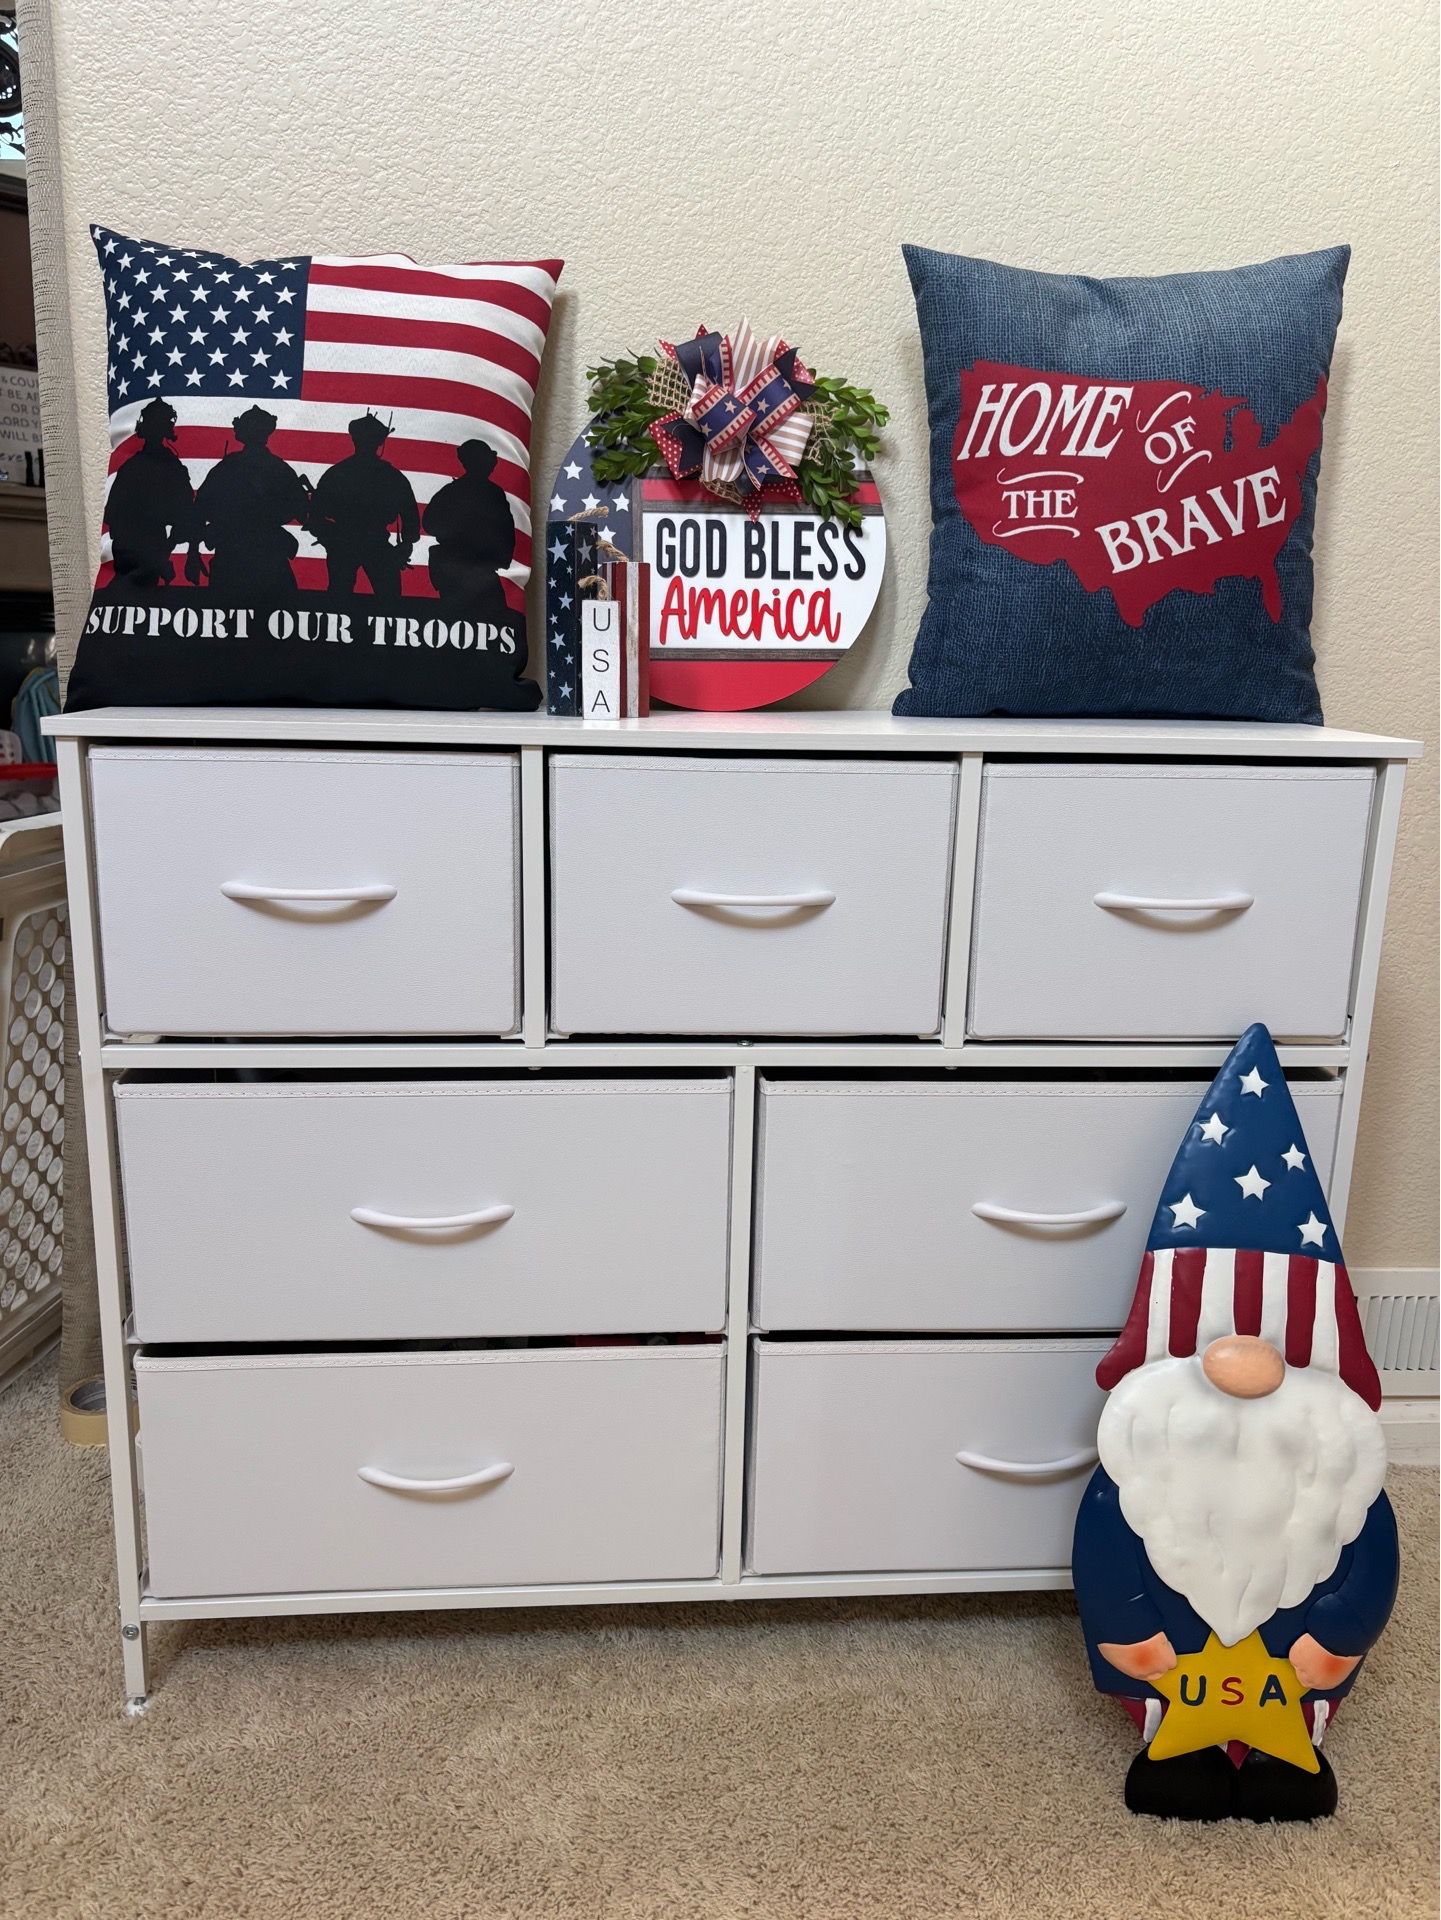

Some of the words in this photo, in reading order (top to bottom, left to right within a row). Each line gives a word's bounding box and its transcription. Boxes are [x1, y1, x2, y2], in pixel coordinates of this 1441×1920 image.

[7, 388, 23, 400] BE
[10, 403, 28, 415] OR
[0, 429, 28, 441] WILL
[957, 382, 1134, 460] HOME
[1144, 416, 1197, 464] OF
[1001, 489, 1079, 519] THE
[1094, 465, 1287, 574] BRAVE
[656, 518, 728, 578] GOD
[744, 521, 867, 580] BLESS
[85, 606, 255, 640] SUPPORT
[267, 609, 354, 644] OUR
[367, 615, 516, 655] TROOPS
[659, 575, 842, 646] America
